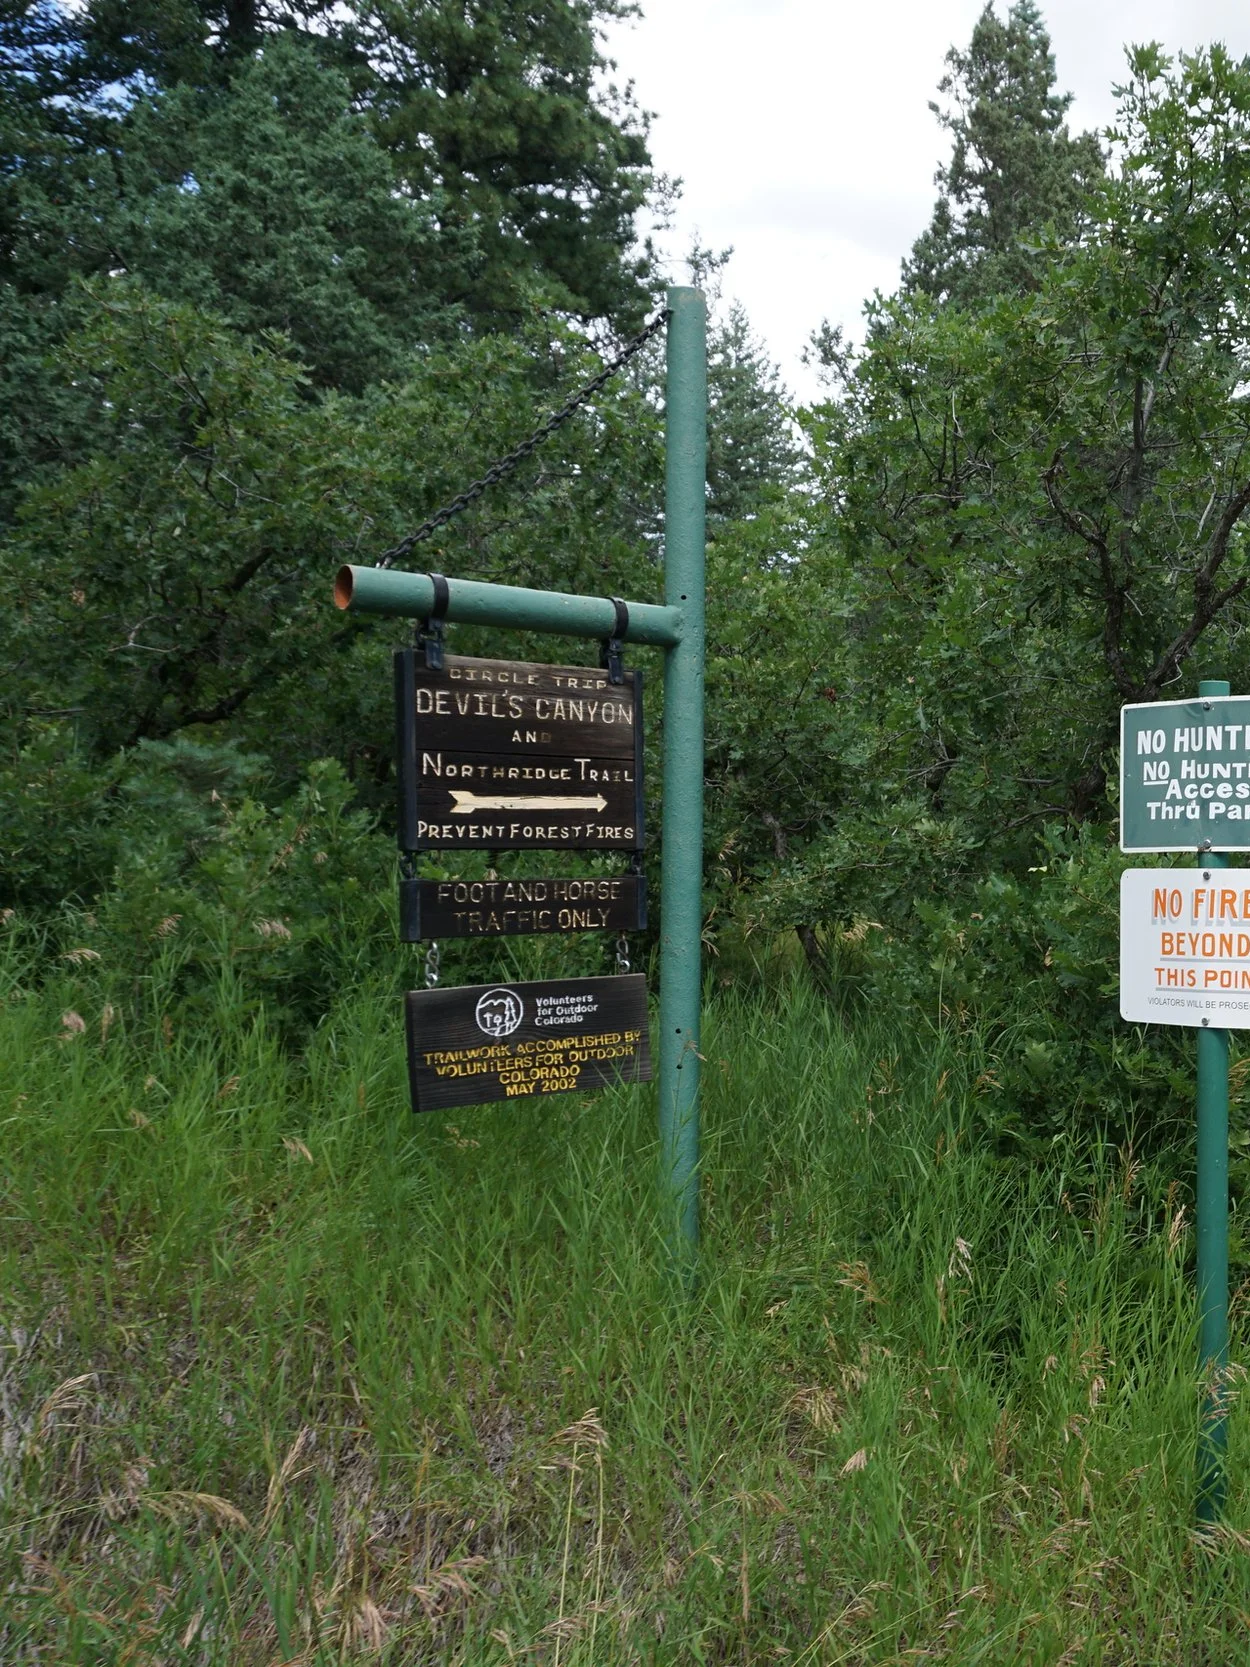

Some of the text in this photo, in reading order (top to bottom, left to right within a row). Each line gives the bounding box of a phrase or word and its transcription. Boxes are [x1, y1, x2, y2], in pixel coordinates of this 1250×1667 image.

[450, 668, 607, 689] CIRCLE TRIP
[416, 688, 633, 724] DEVIL'S CANYON
[1137, 730, 1166, 754] NO
[1143, 761, 1170, 781] NO
[1147, 800, 1199, 820] Thru
[417, 821, 634, 839] PREVENT FOREST FIRES
[438, 881, 623, 903] FOOT AND HORSE
[1153, 888, 1183, 918] NO
[453, 909, 611, 932] TRAFFIC ONLY
[1161, 932, 1250, 957] BEYOND
[1154, 968, 1196, 987] THIS
[536, 994, 593, 1006] Volunteers
[537, 1004, 598, 1016] for Outdoor
[1148, 997, 1185, 1007] VIOLATORS
[1187, 1000, 1203, 1008] WILL
[1205, 1001, 1216, 1009] BE
[534, 1014, 583, 1026] Colorado
[423, 1045, 511, 1066] TRAILWORK
[517, 1032, 620, 1054] ACCOMPLISHED
[536, 1053, 563, 1069] FOR
[569, 1046, 634, 1063] OUTDOOR
[499, 1065, 580, 1084] COLORADO
[506, 1079, 576, 1096] MAY 2002
